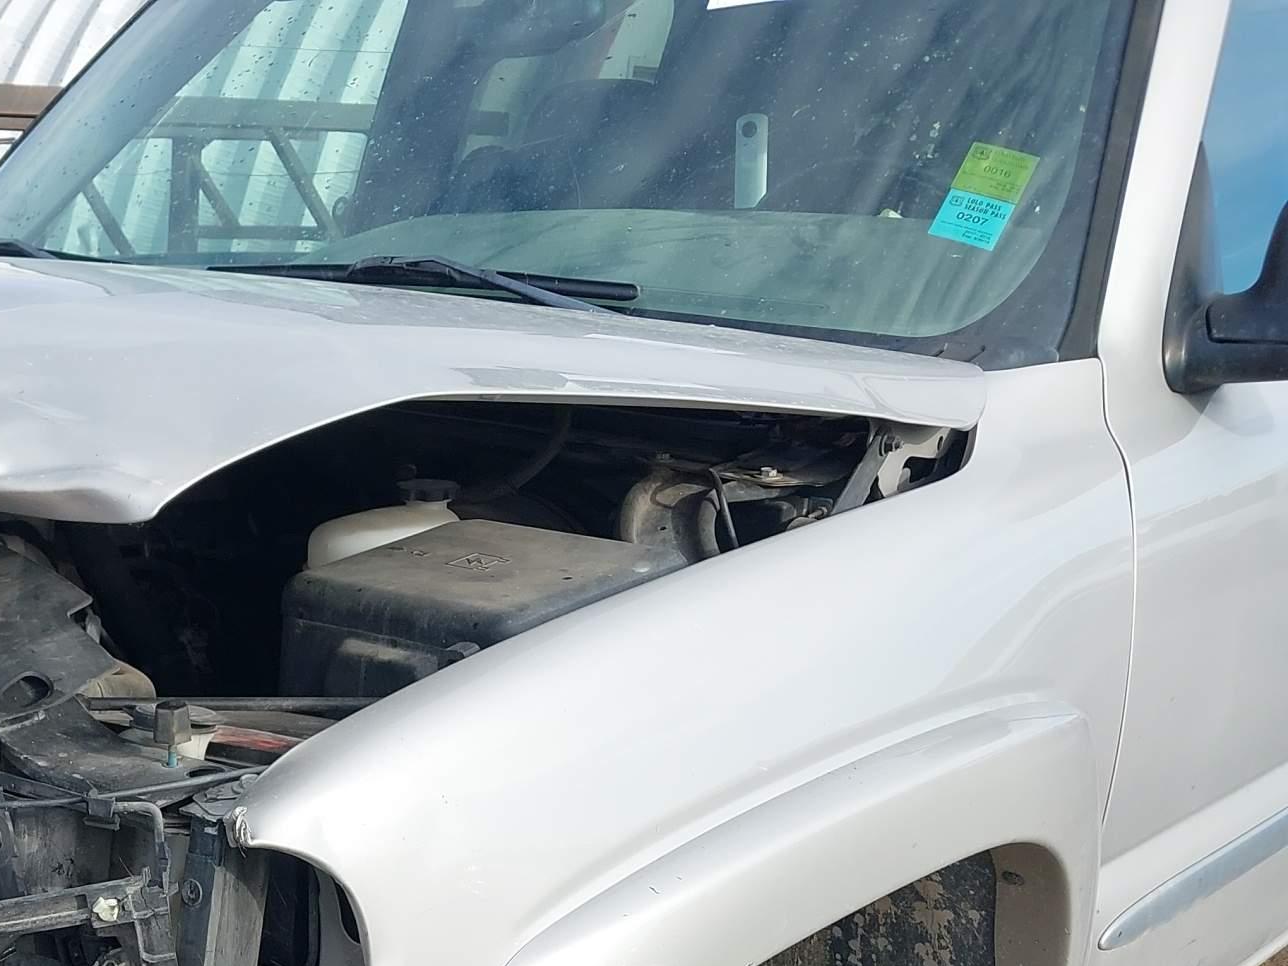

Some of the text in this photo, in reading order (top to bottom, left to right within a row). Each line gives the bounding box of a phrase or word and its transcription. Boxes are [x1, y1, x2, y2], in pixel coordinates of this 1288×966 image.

[964, 204, 1007, 220] SEASON PASS
[985, 202, 1002, 211] PASS
[956, 211, 989, 226] 0207
